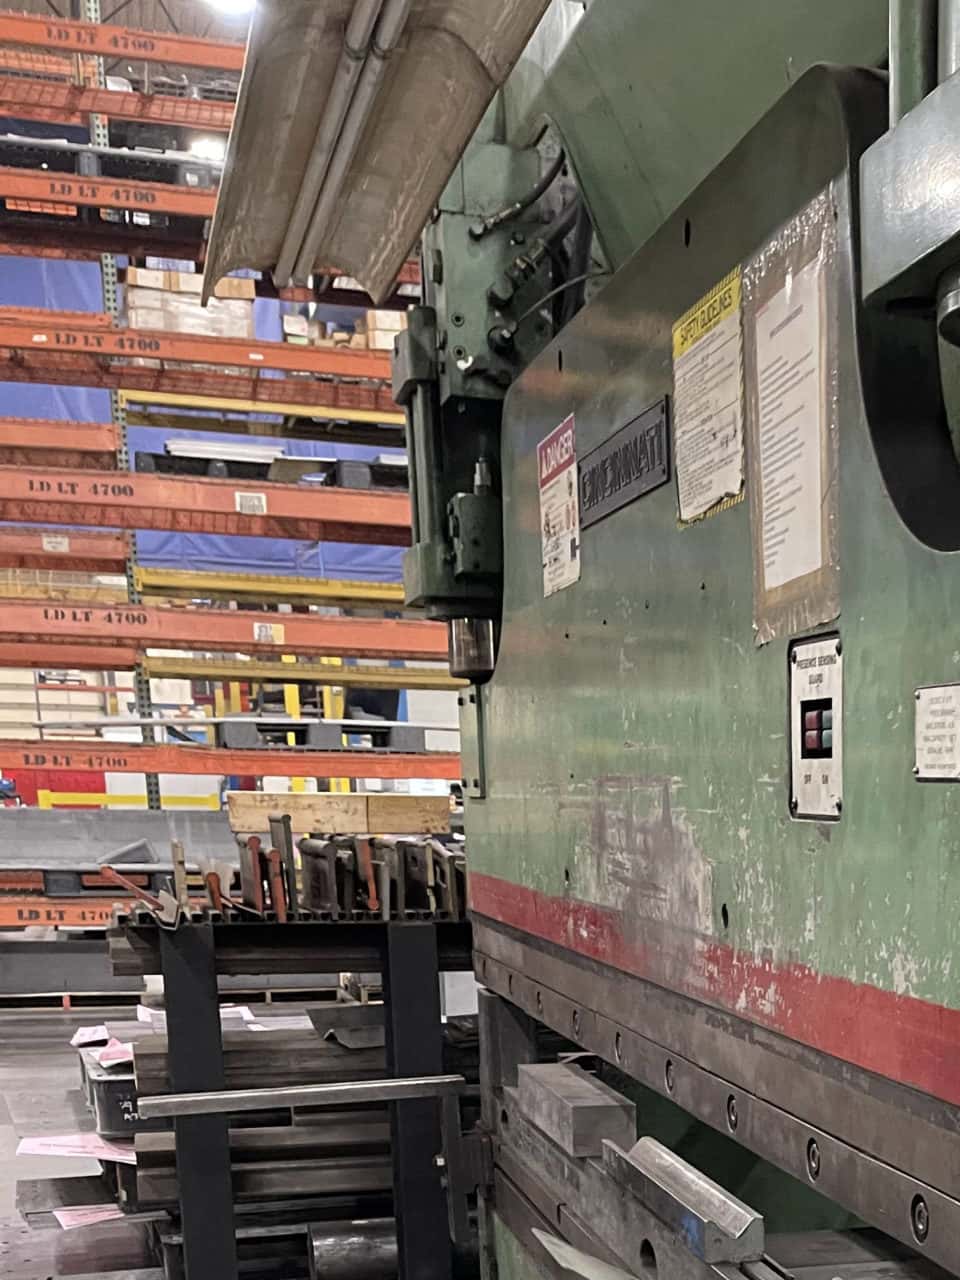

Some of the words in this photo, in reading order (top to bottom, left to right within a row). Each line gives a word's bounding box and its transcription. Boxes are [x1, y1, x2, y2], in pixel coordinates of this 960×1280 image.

[545, 430, 573, 474] DANGER
[582, 420, 664, 512] CINCINNATI
[88, 483, 134, 497] 4700
[103, 611, 147, 625] 4700
